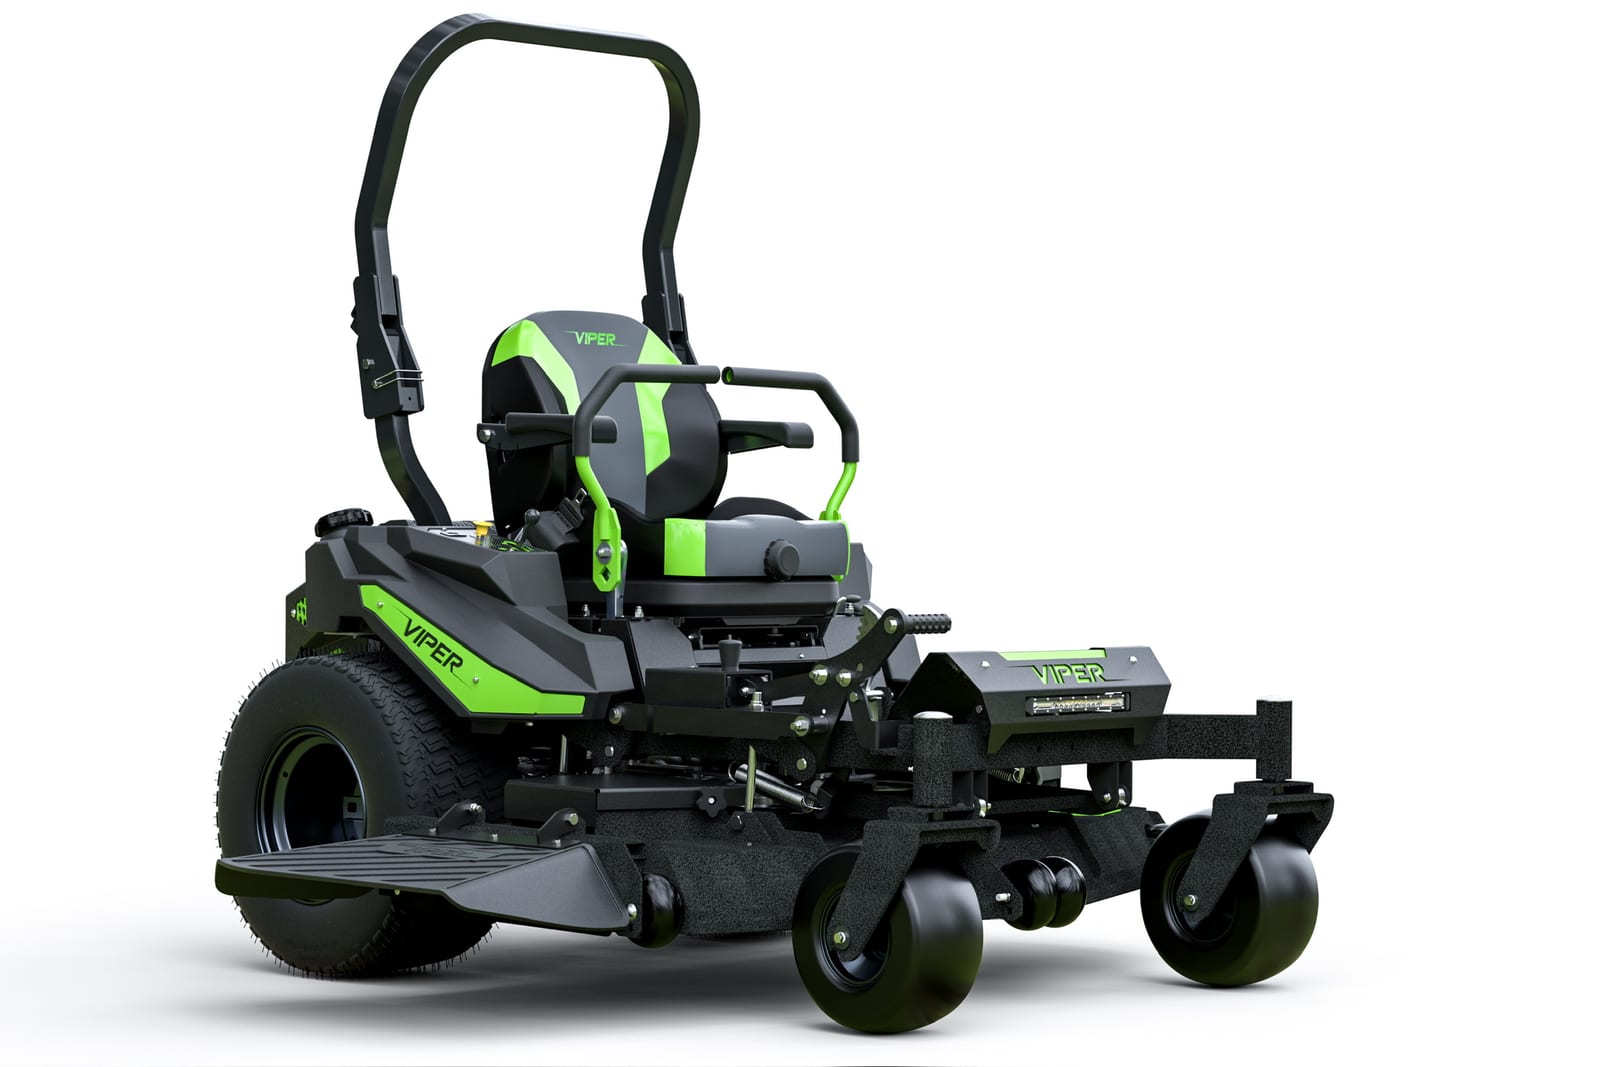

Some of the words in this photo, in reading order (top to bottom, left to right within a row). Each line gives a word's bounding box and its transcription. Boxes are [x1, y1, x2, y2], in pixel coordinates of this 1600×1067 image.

[575, 331, 617, 347] VIPER
[403, 617, 464, 673] VIPER
[1031, 662, 1106, 685] VIPER
